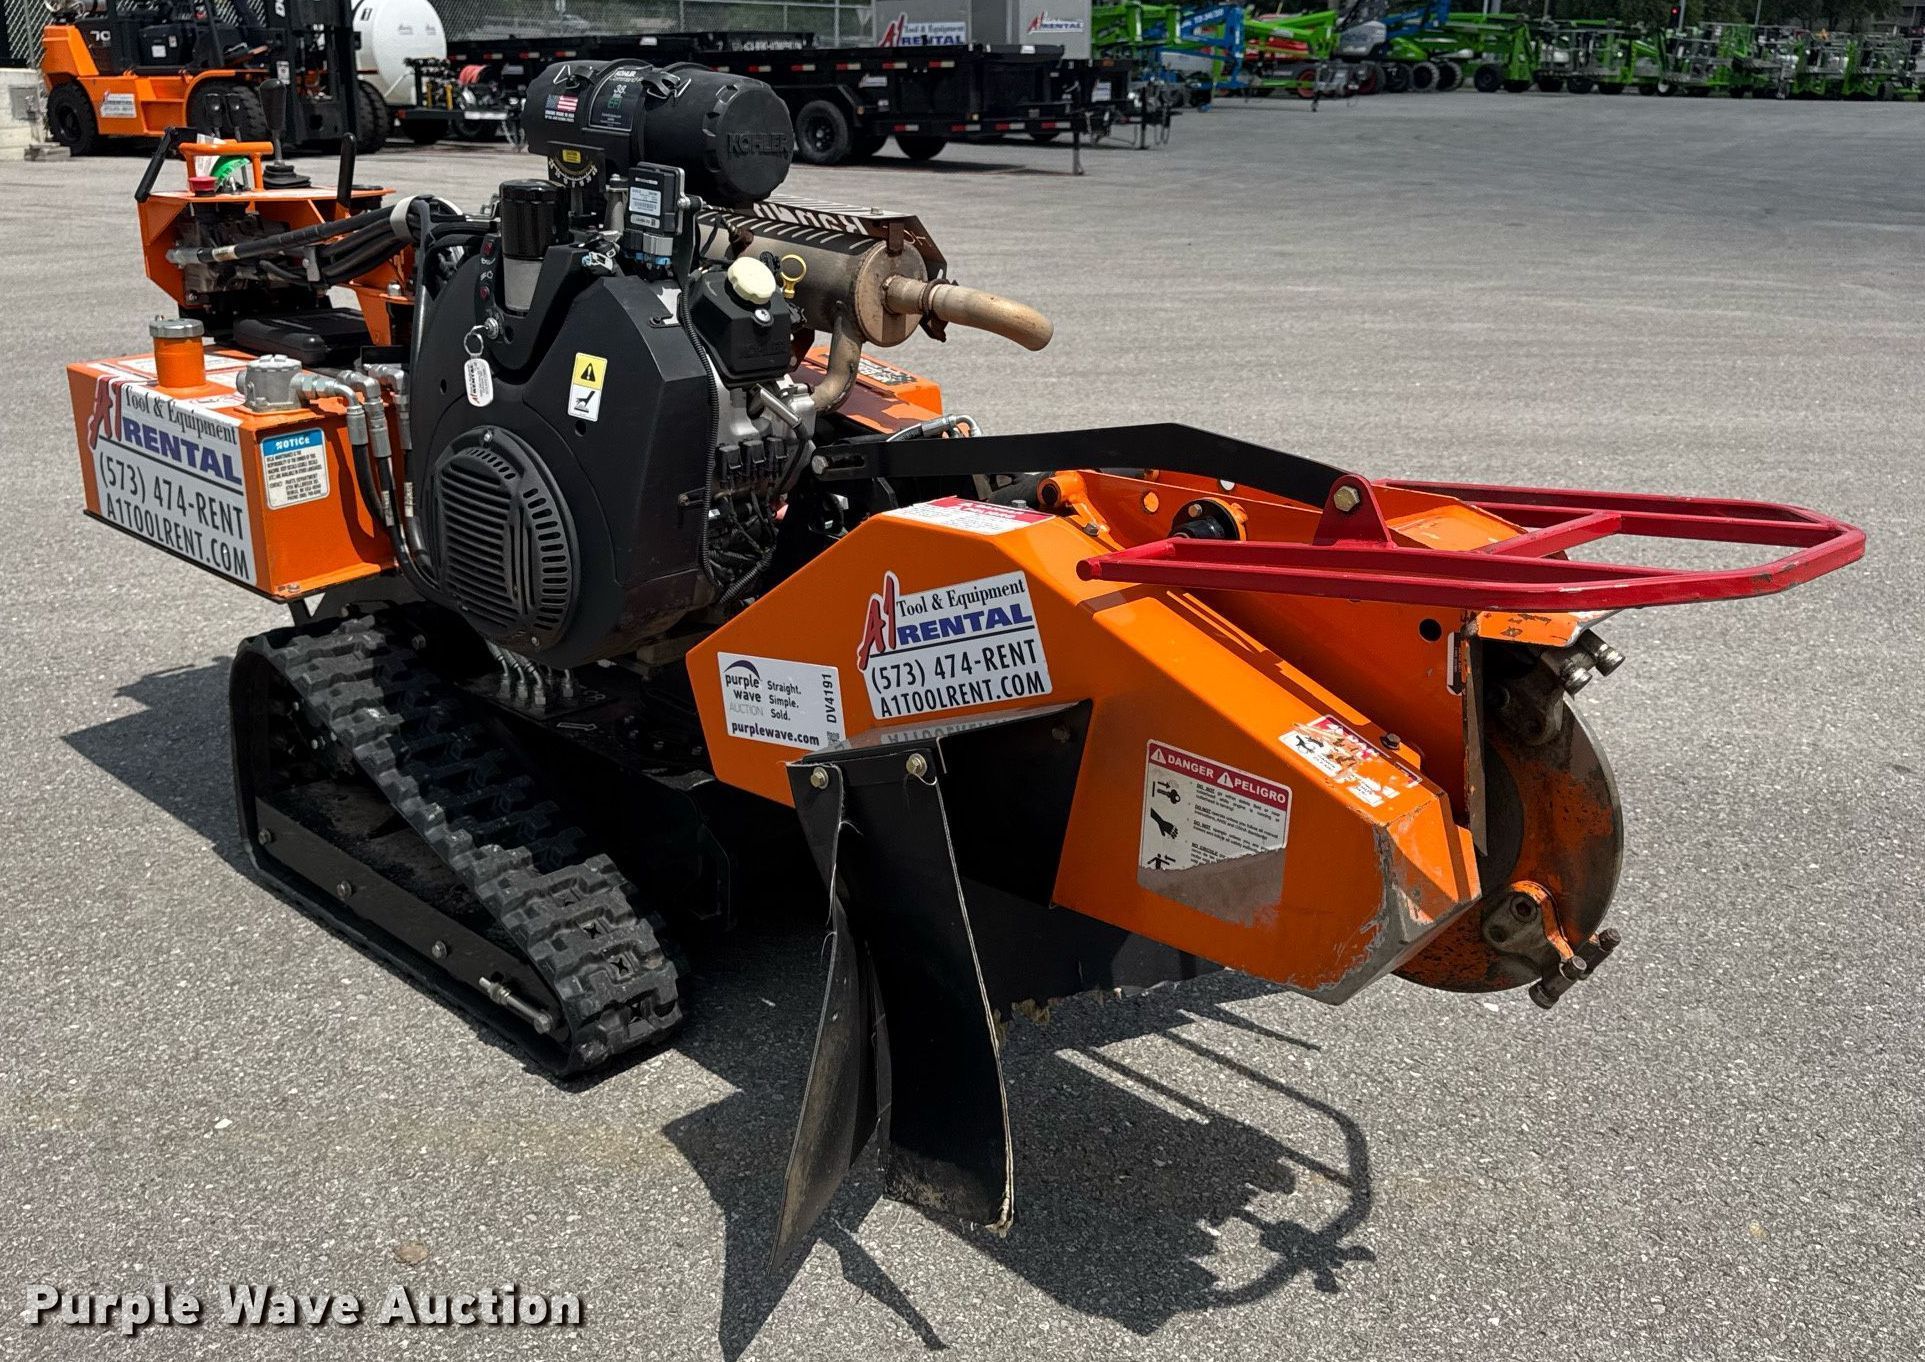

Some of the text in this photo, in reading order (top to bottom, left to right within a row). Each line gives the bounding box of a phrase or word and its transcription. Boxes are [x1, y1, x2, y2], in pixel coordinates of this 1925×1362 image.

[726, 131, 789, 155] KOHLER
[90, 376, 124, 450] A1
[126, 385, 238, 445] Tool & Equipment
[122, 417, 242, 486] RENTAL
[275, 436, 310, 450] NOTICE
[100, 452, 244, 541] (573) 474-RENT
[107, 493, 250, 580] A1TOOLRENT.COM
[896, 579, 1025, 617] Tool & Equipment
[859, 575, 896, 671] A1
[897, 603, 1033, 646] RENTAL
[725, 674, 760, 689] purple
[872, 639, 1037, 694] (573) 474-RENT
[733, 690, 762, 702] wave
[767, 680, 801, 695] Straight.
[769, 695, 799, 708] Simple.
[821, 673, 837, 724] DV4191
[881, 670, 1045, 718] A1TOOLRENT.COM
[729, 702, 764, 716] AUCTION
[770, 709, 791, 721] Sold.
[731, 722, 820, 746] purplewave.com
[1167, 754, 1215, 779] DANGER
[1234, 778, 1286, 804] PELIGRO
